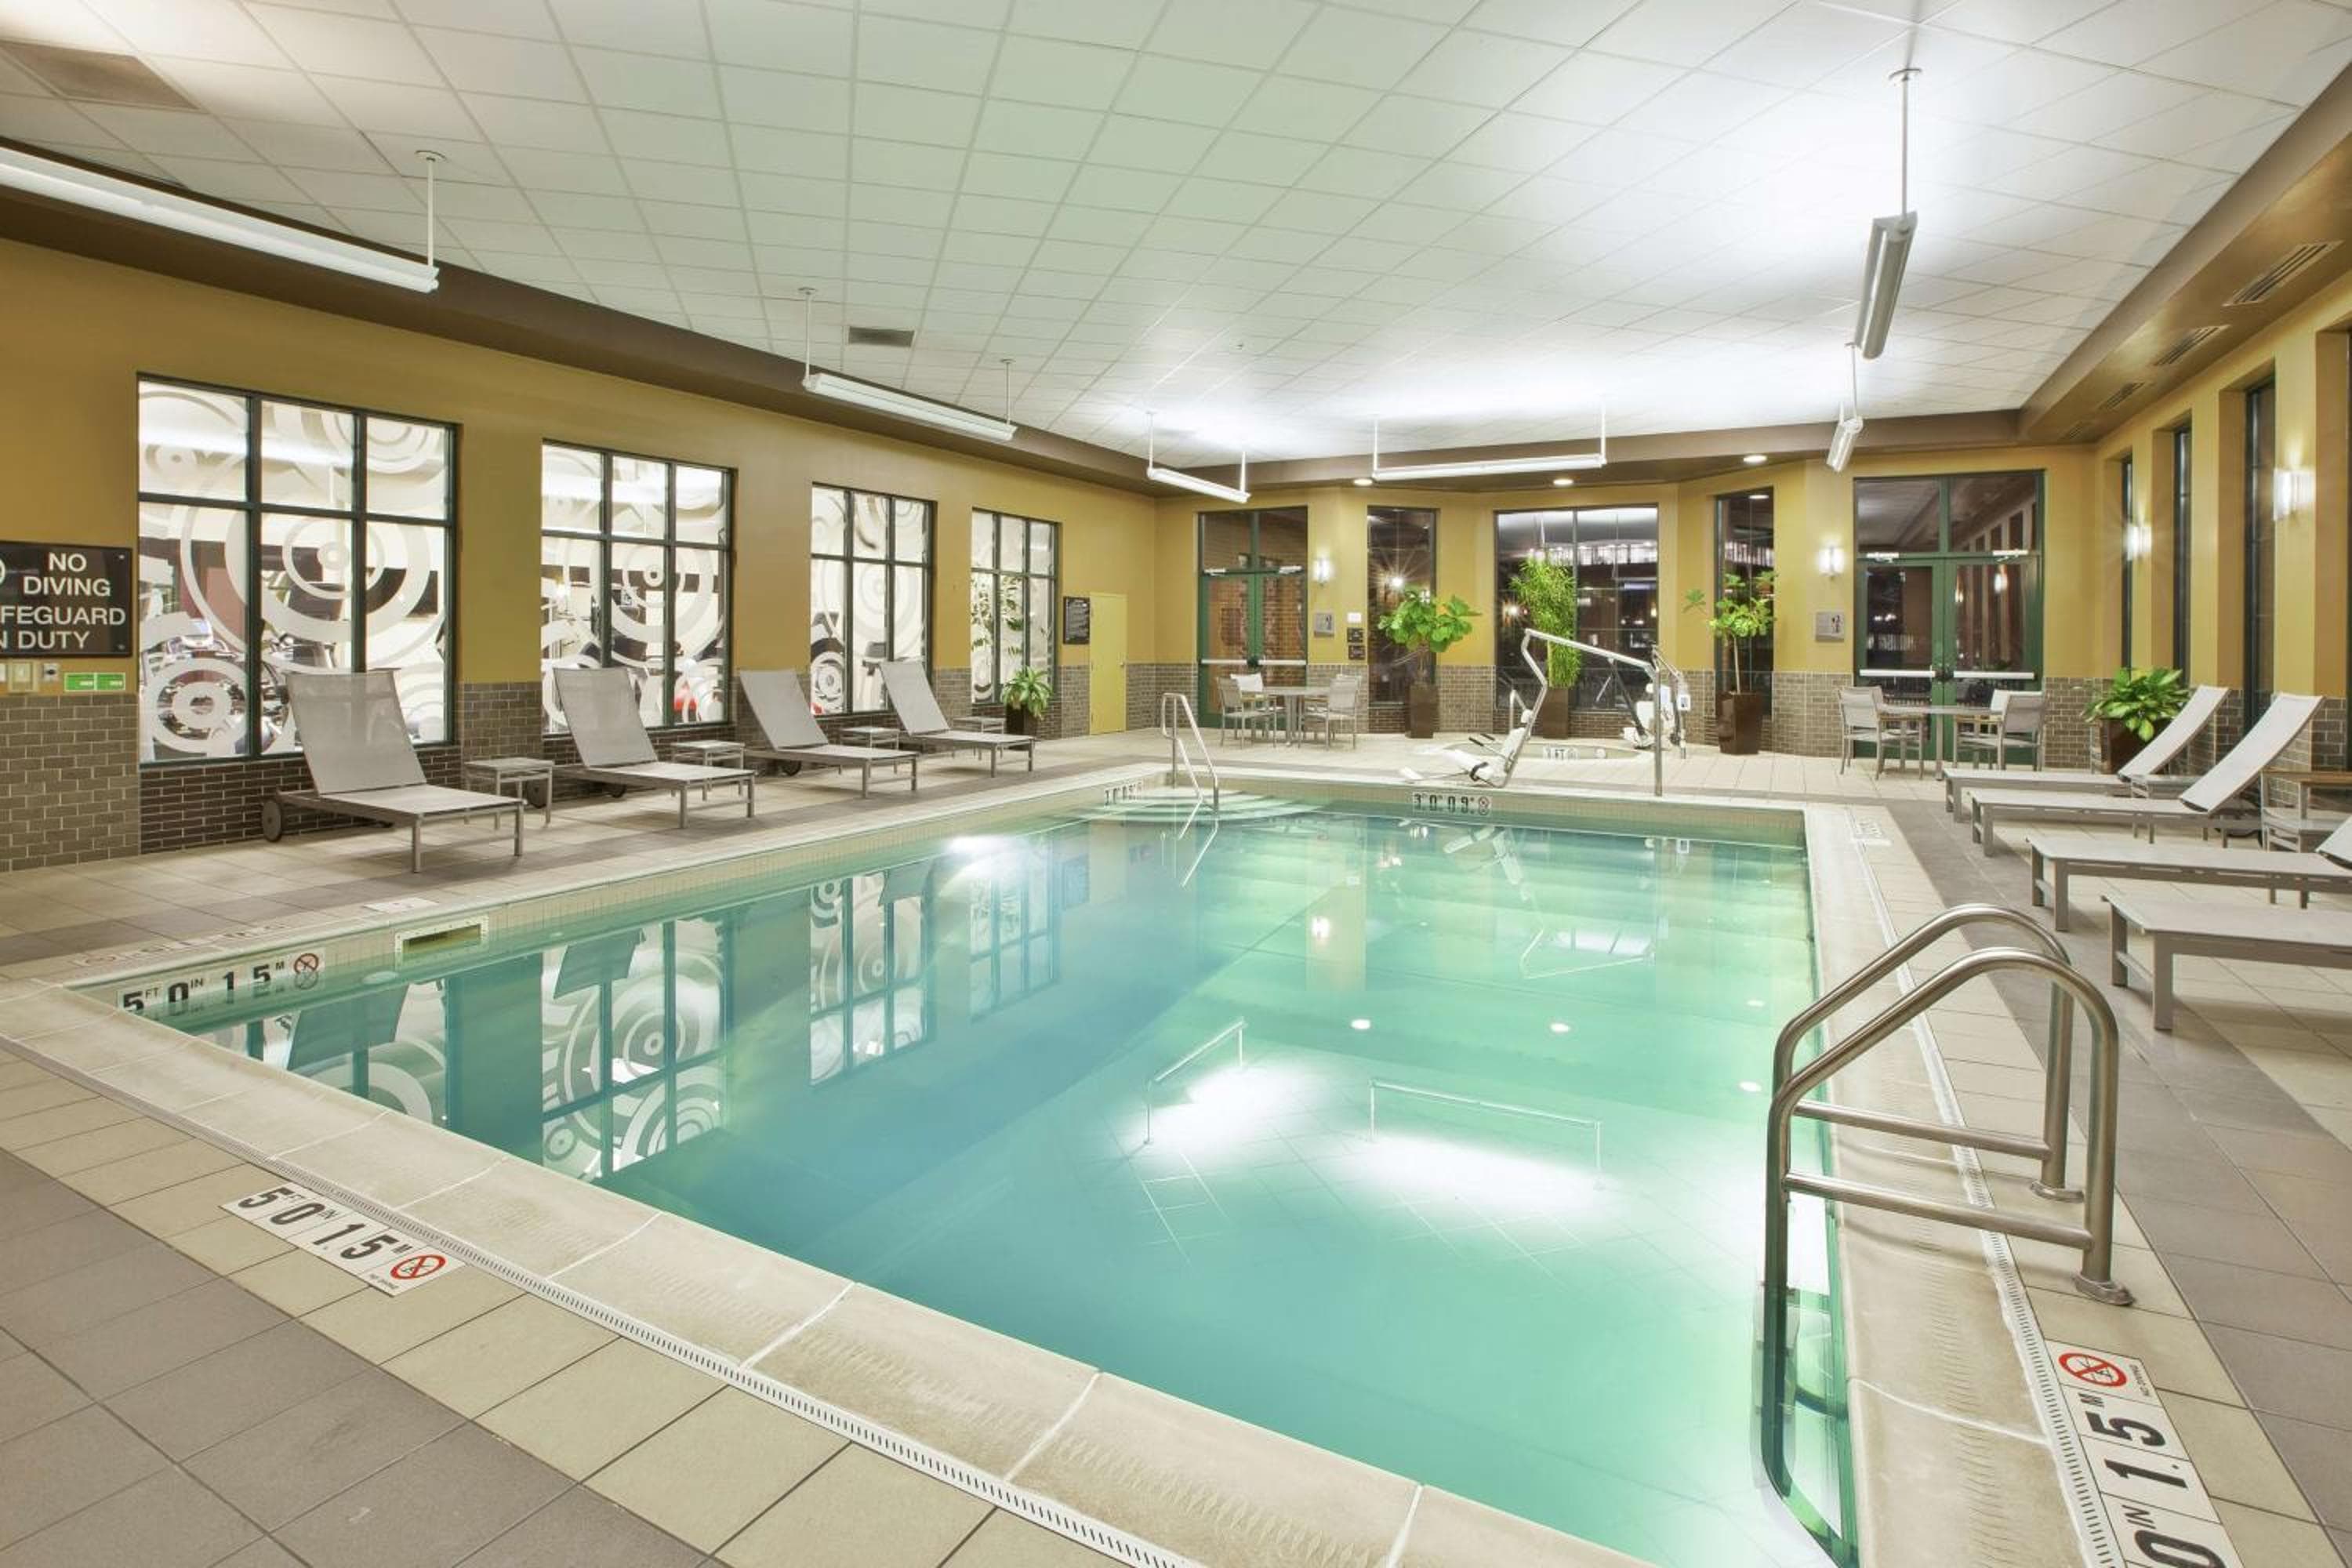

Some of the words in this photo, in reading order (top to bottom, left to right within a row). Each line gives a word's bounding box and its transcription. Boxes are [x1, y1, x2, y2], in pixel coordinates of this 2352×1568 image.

[49, 552, 87, 572] NO
[24, 575, 111, 597] DIVING
[18, 630, 90, 649] DUTY
[123, 990, 144, 1011] 5
[2122, 1504, 2157, 1530] IN
